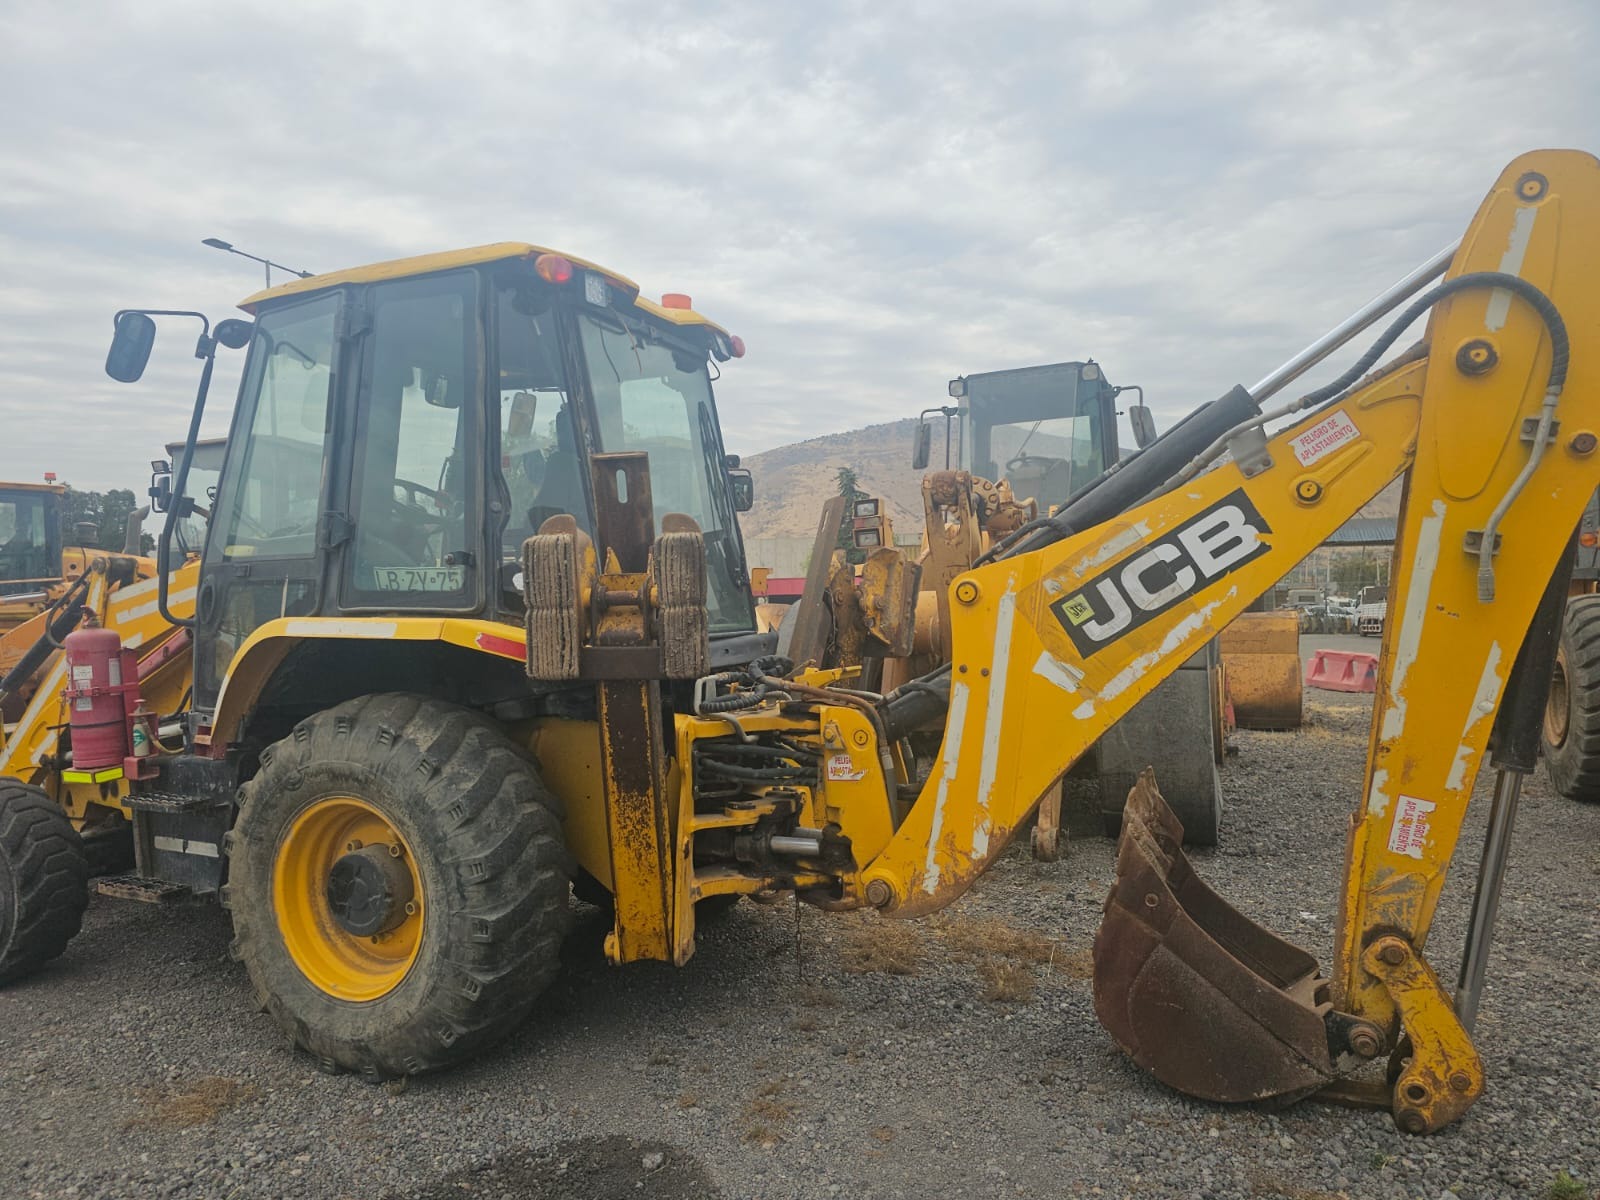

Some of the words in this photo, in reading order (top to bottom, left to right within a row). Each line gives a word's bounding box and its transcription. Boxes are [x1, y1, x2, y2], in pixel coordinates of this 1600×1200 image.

[1299, 425, 1329, 447] PELIGRO
[1327, 419, 1339, 430] DE
[1301, 424, 1353, 461] APLASTAMIENTO
[1081, 504, 1263, 643] JCB
[1395, 800, 1417, 852] APLASAMIENTO
